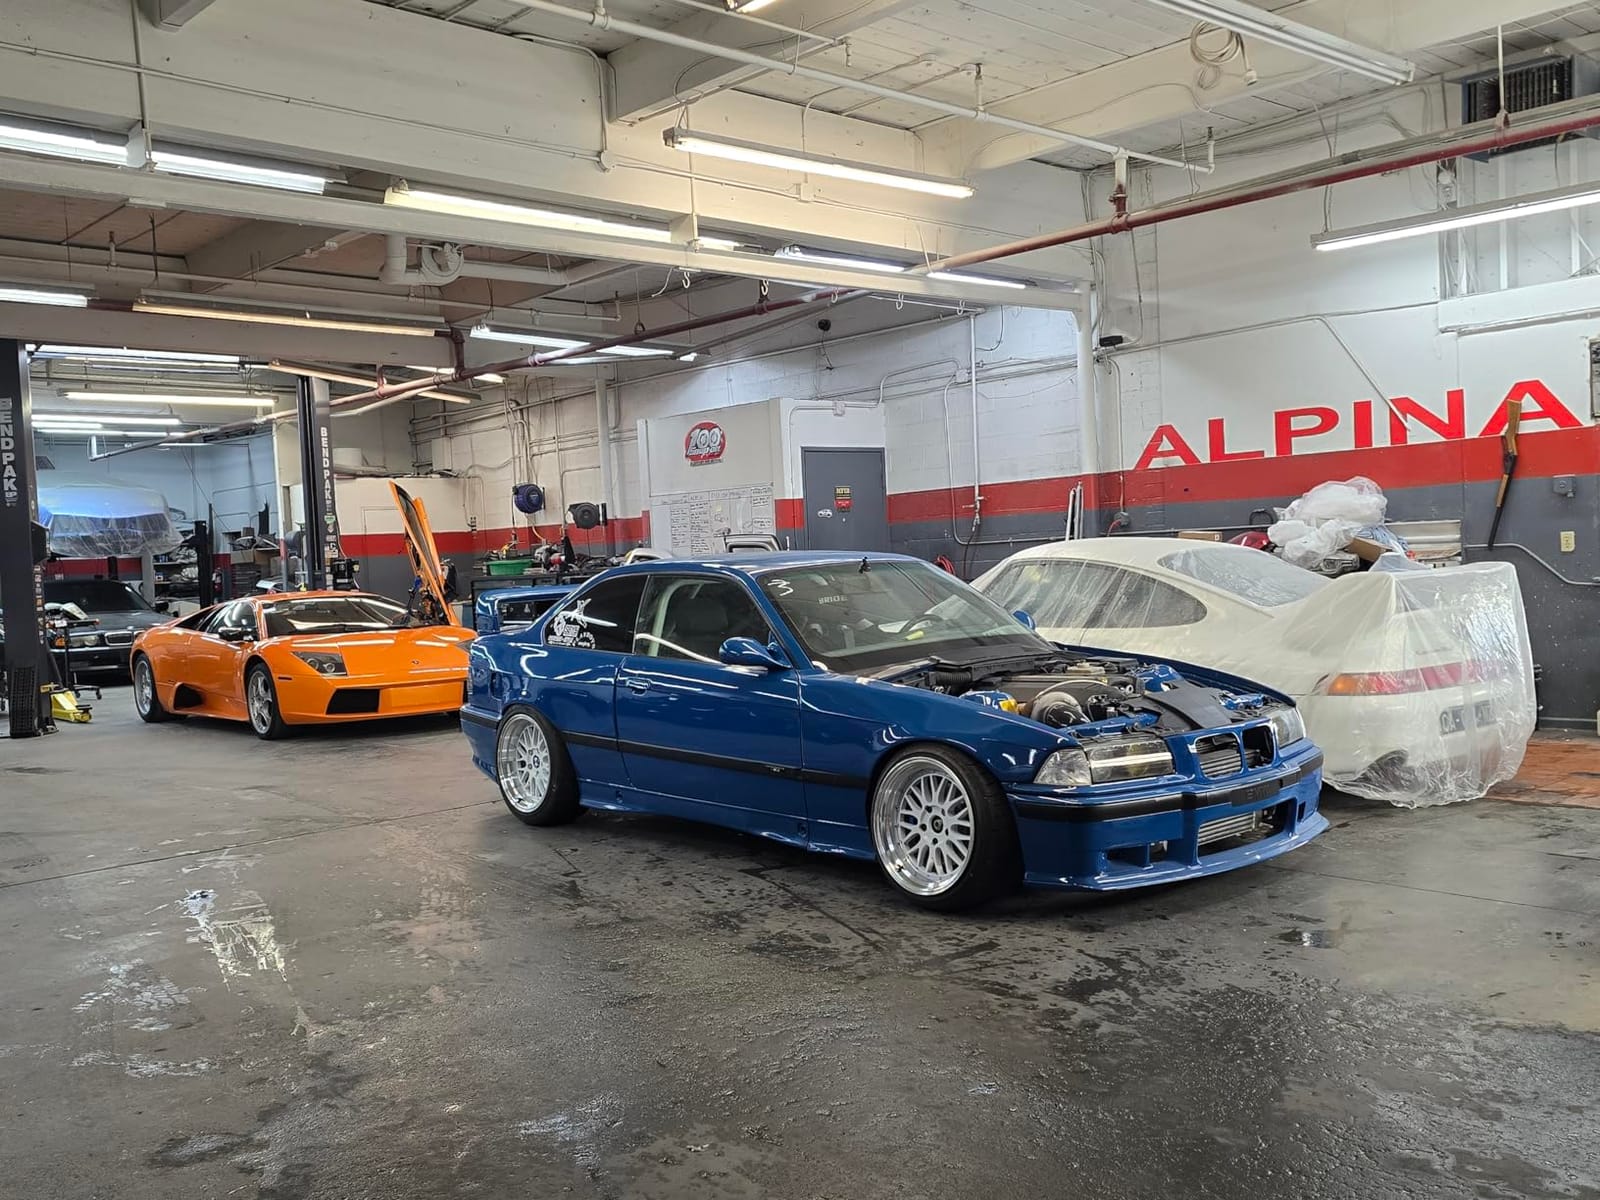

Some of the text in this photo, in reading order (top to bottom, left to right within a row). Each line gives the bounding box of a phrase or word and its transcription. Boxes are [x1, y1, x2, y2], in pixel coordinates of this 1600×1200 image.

[0, 397, 18, 491] BENDPAK
[320, 427, 332, 500] BENDPAK
[1133, 379, 1584, 470] ALPINA
